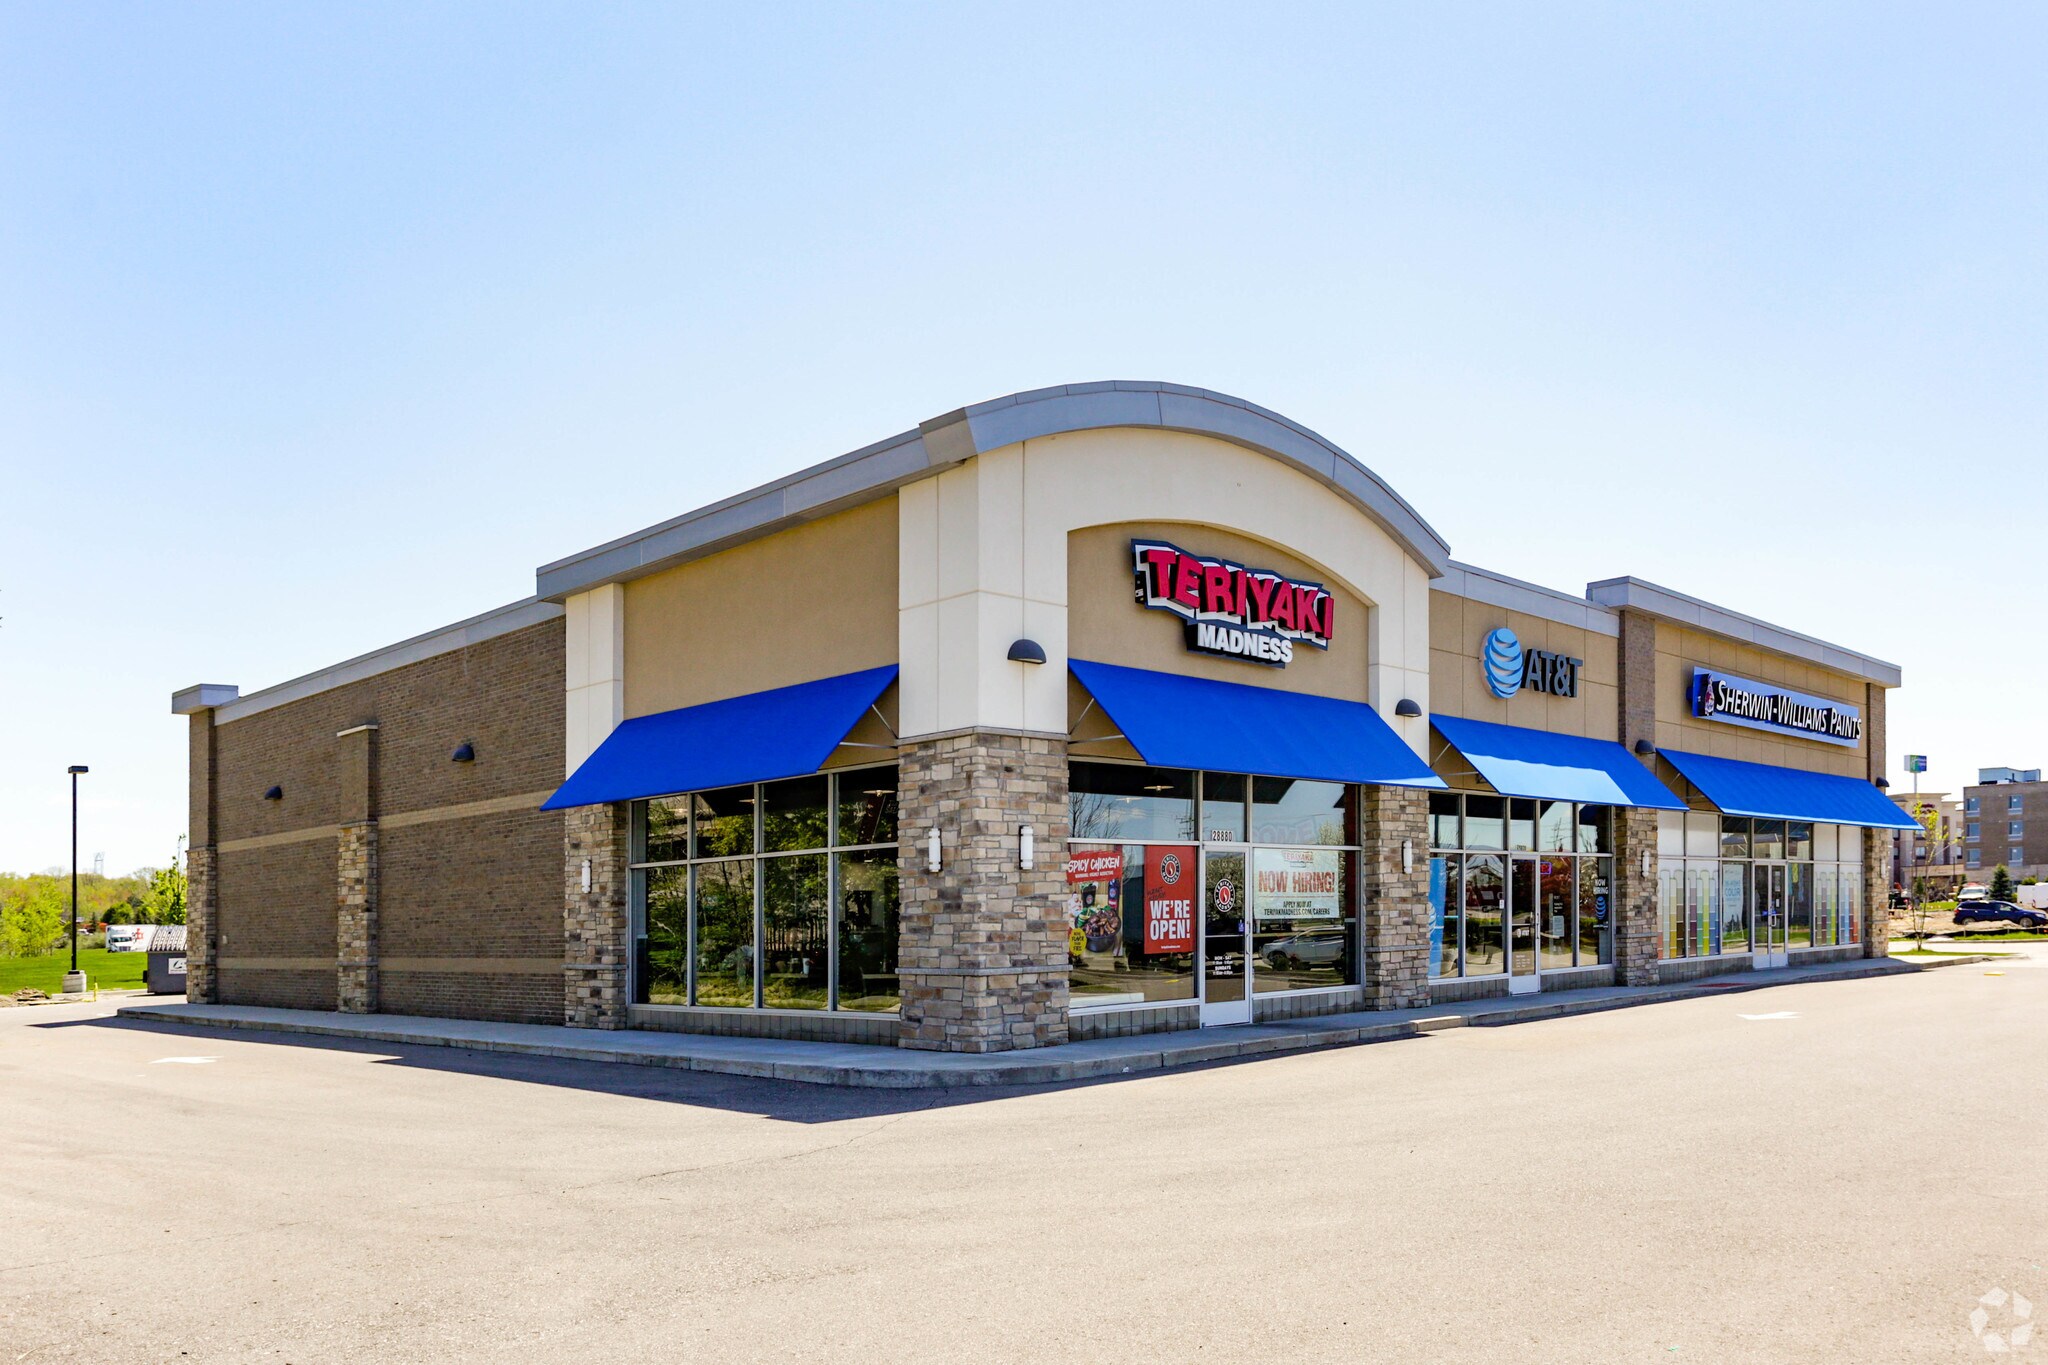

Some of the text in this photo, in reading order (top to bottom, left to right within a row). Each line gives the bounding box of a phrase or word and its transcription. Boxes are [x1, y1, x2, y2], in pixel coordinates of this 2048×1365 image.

[1146, 548, 1335, 640] TERIYAKI
[1197, 623, 1294, 664] MADNESS
[1523, 648, 1584, 698] AT&T
[1716, 680, 1863, 740] SHERWIN-WILLIAMS PAINTS
[1212, 830, 1233, 842] 28880
[1067, 855, 1120, 873] SPICY CHICKEN
[1258, 871, 1335, 893] NOW HIRING!
[1150, 900, 1190, 919] WE'RE
[1150, 919, 1190, 940] OPEN!
